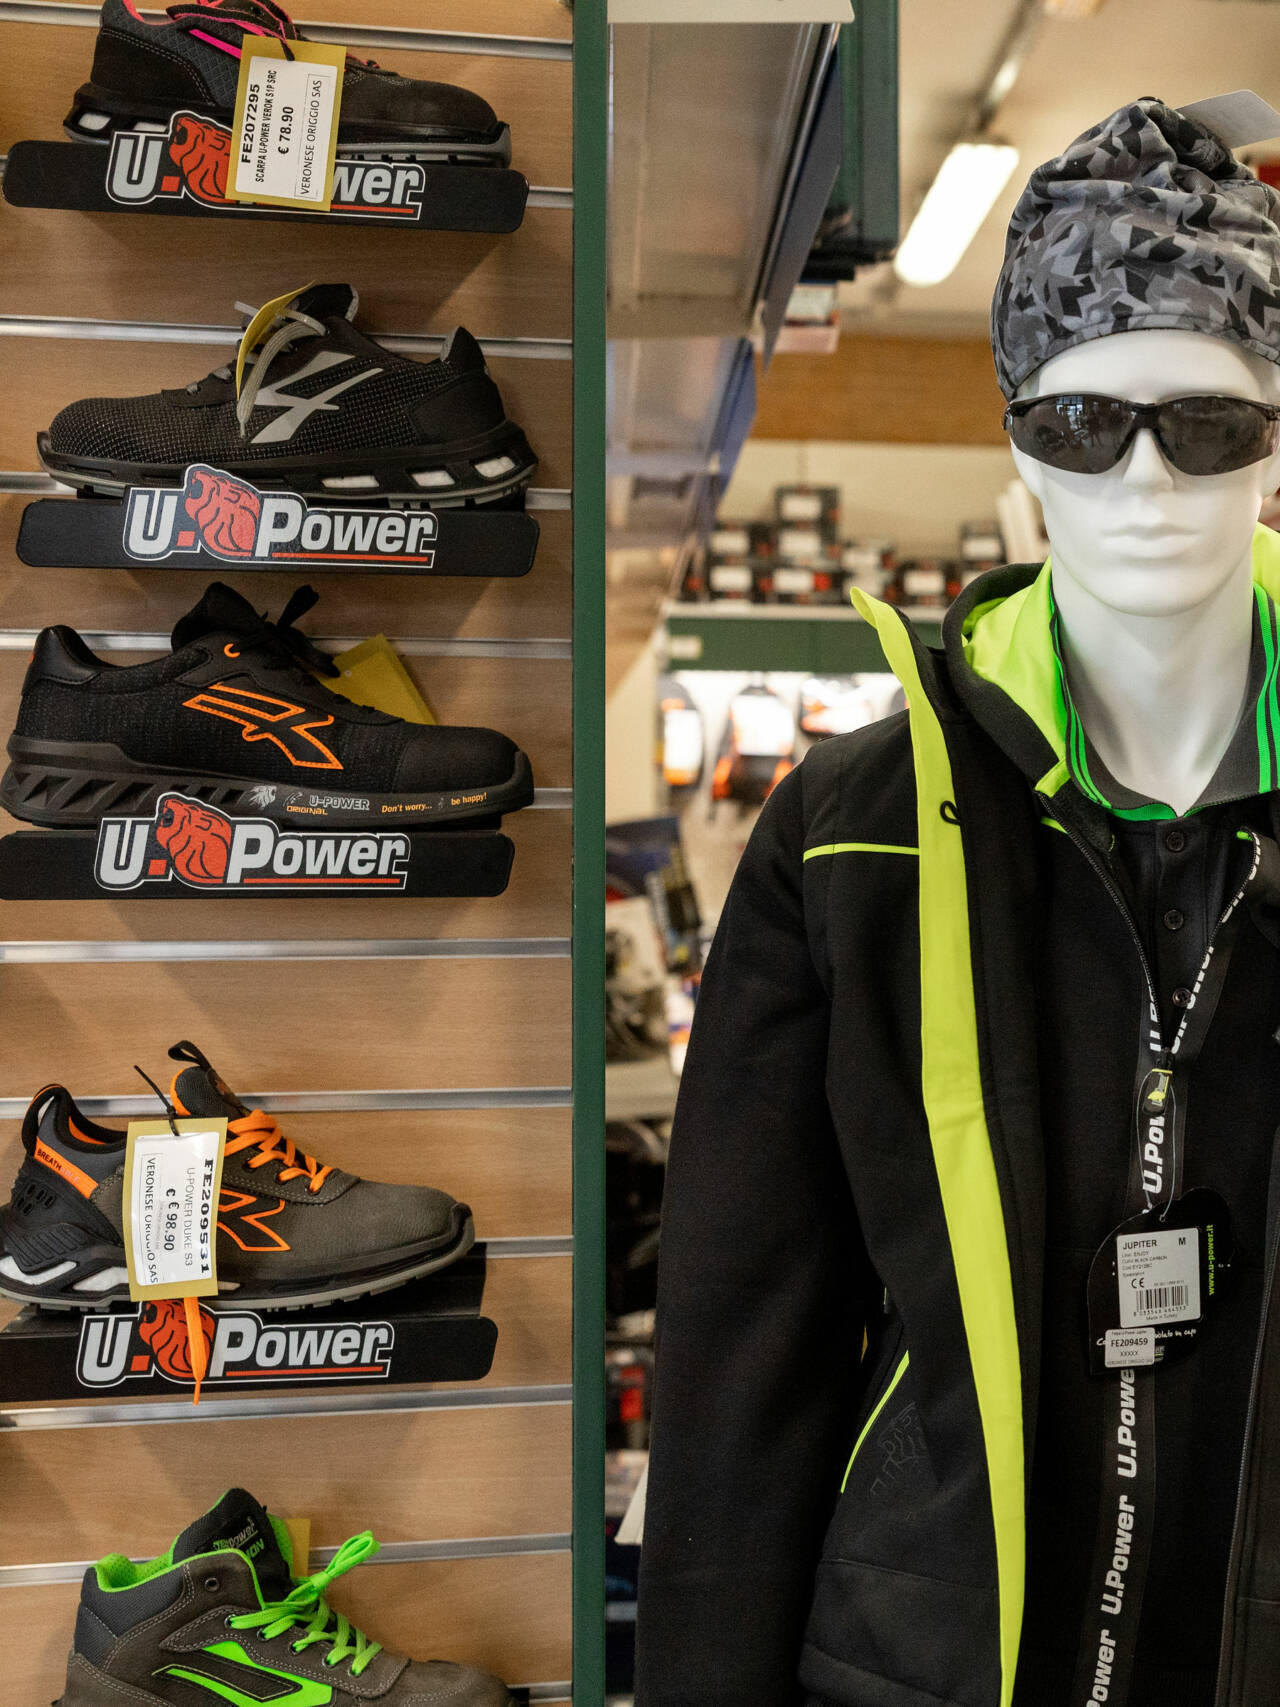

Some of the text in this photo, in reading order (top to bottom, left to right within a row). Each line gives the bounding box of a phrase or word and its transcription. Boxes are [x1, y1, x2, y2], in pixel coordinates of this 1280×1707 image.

[241, 83, 260, 163] FE207295
[255, 70, 278, 183] SCARPA U-POWER VEROK S1P SRC
[278, 106, 294, 155] € 78.90
[301, 80, 322, 195] VERONESE ORIGGIO SAS
[332, 165, 422, 205] wer
[255, 498, 434, 557] Power
[309, 795, 370, 810] U-POWER
[381, 804, 403, 813] Don't
[451, 798, 461, 806] be
[463, 792, 487, 804] happy!
[226, 824, 406, 884] Power
[145, 1158, 156, 1211] VERONESE
[183, 1220, 193, 1249] DUKE
[199, 1158, 214, 1274] FE209531
[1123, 1237, 1187, 1250] JUPITER M
[148, 1263, 159, 1284] SAS
[185, 1252, 193, 1266] S3
[1206, 1224, 1215, 1296] www.u-power.it
[209, 1317, 389, 1378] Power
[1110, 1338, 1149, 1348] FE209459
[1117, 1369, 1138, 1479] U.Powe
[1101, 1495, 1136, 1616] U.Power
